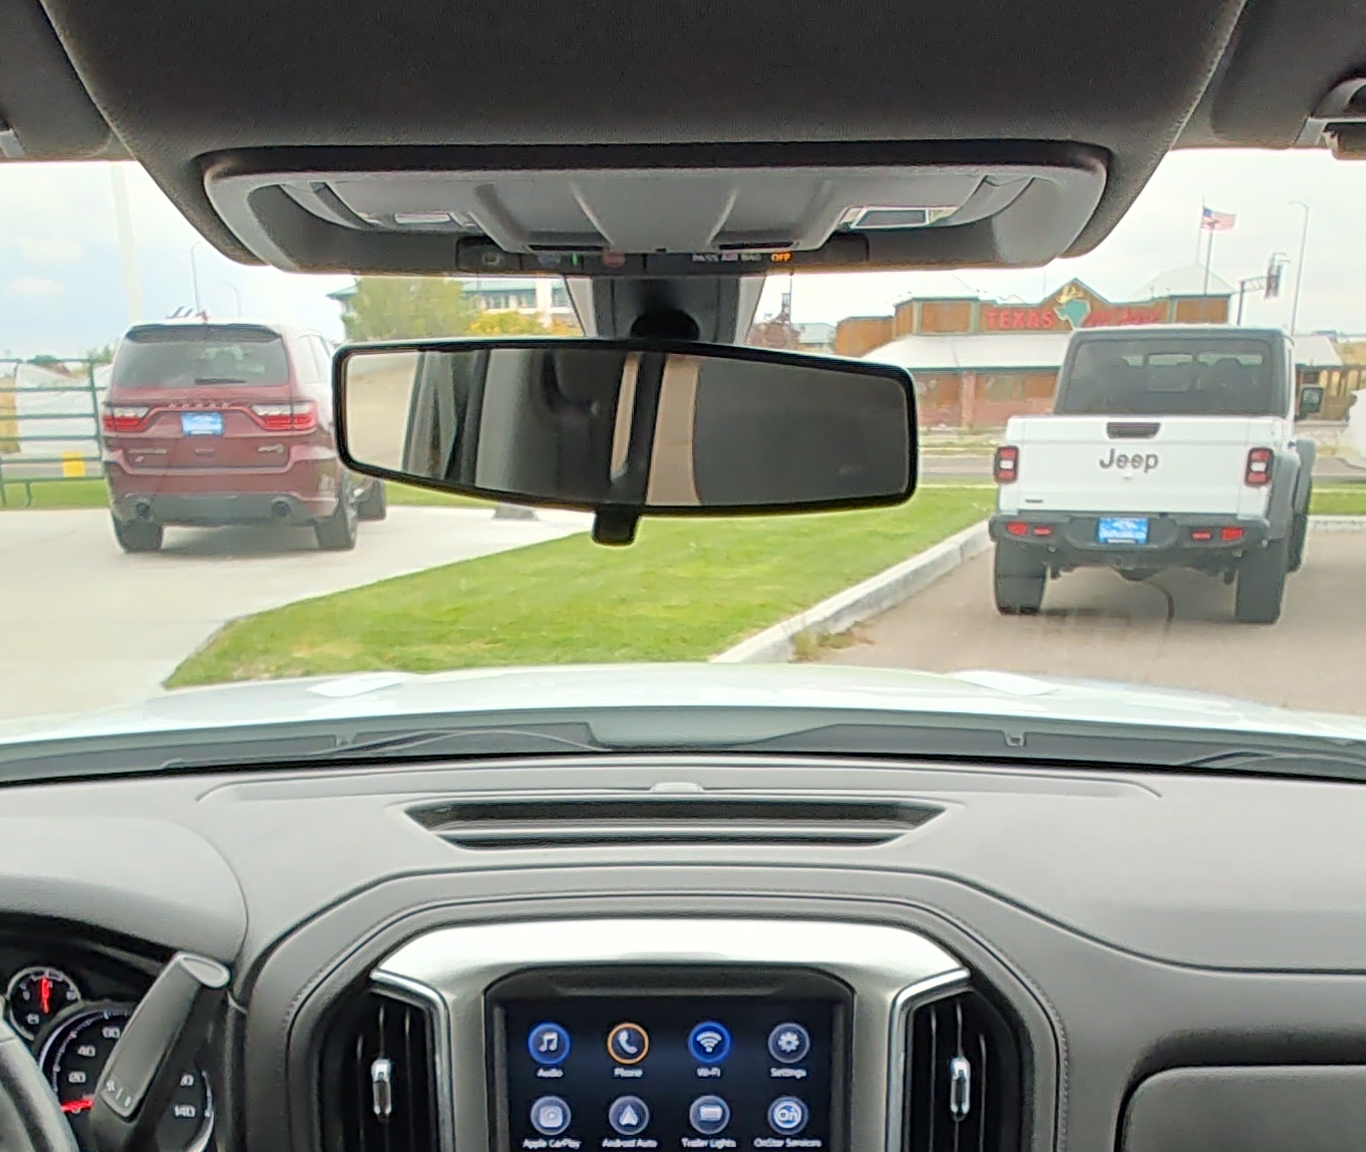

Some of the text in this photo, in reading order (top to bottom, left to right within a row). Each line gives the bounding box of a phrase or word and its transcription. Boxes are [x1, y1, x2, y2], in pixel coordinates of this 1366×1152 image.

[770, 253, 792, 262] OFF
[986, 309, 1055, 329] TEXAS
[1099, 447, 1159, 474] Jeep
[77, 1045, 96, 1057] 40
[537, 1067, 564, 1078] Audio
[613, 1067, 643, 1078] Phone
[770, 1067, 807, 1080] Settings
[175, 1105, 195, 1117] 140
[522, 1138, 581, 1149] Apple CarPlay
[602, 1138, 658, 1148] Android Auto
[681, 1138, 737, 1149] Trailer Lights
[786, 1138, 823, 1148] Services
